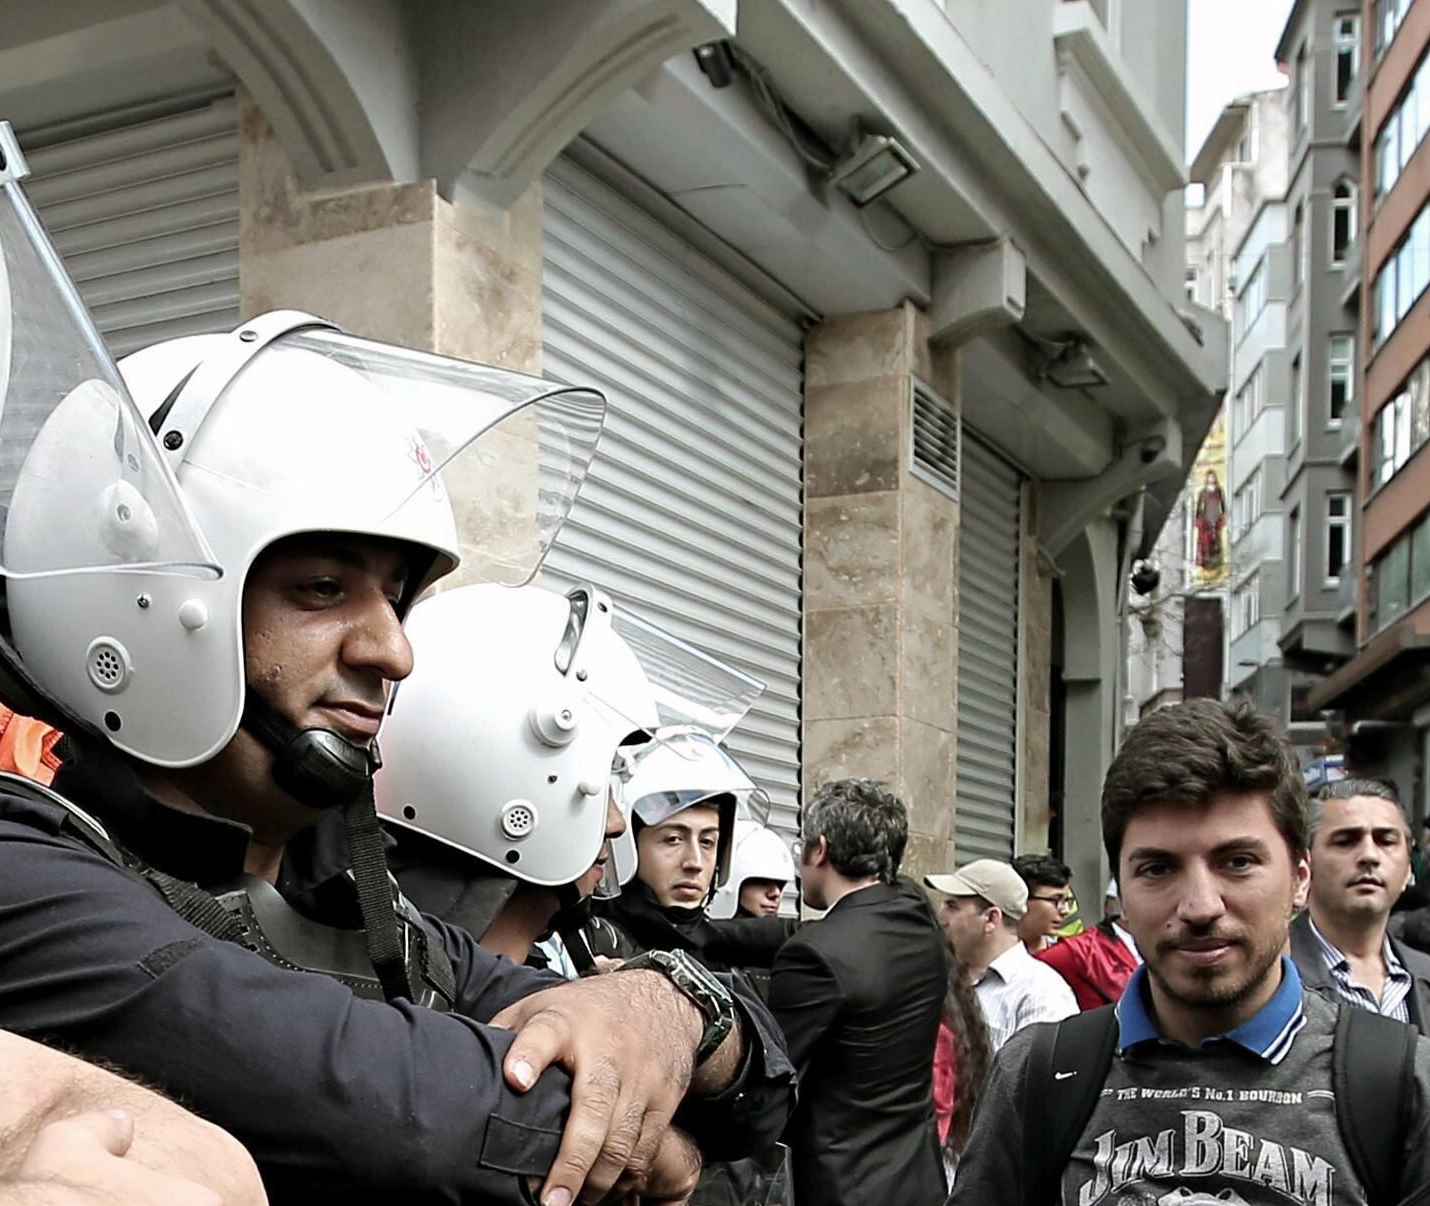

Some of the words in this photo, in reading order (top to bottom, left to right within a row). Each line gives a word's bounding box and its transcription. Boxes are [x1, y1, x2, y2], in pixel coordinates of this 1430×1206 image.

[1117, 1087, 1139, 1101] THE
[1141, 1086, 1202, 1100] WORLD'S
[1239, 1089, 1303, 1105] BOURBON
